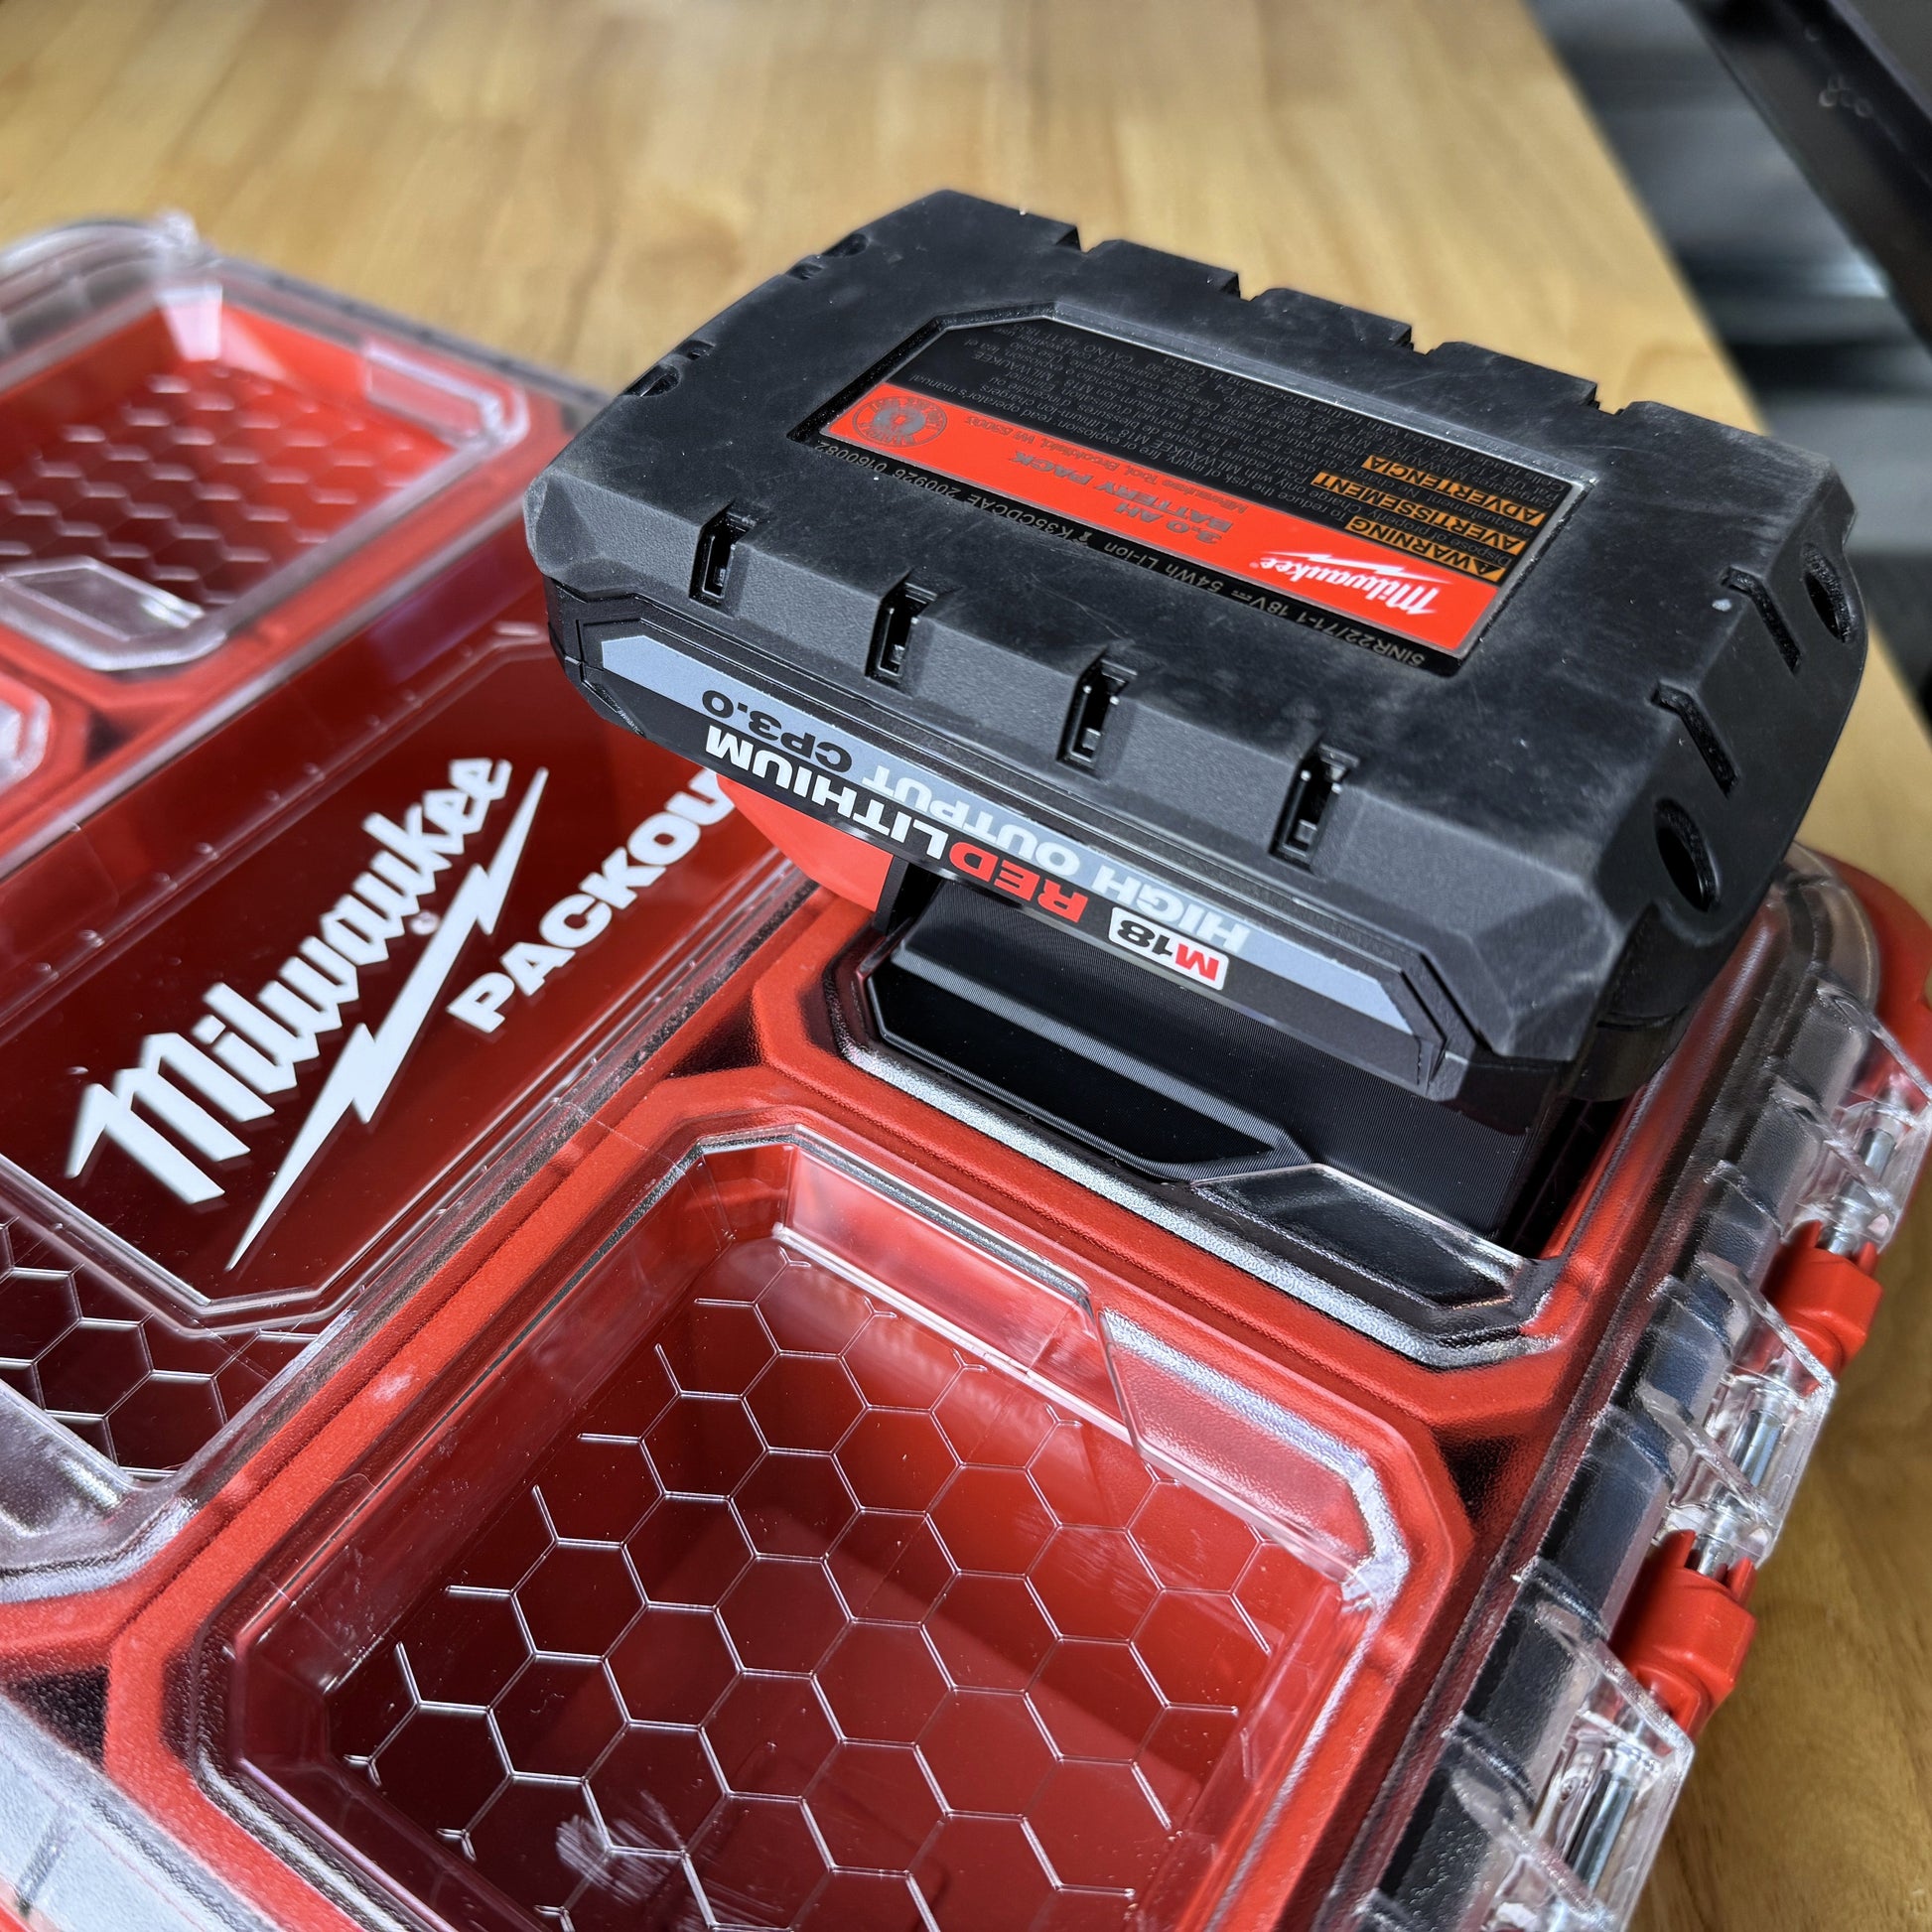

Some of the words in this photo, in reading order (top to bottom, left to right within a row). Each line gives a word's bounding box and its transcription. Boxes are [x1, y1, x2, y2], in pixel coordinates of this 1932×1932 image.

[988, 376, 1008, 386] ou
[958, 388, 1022, 412] operator's
[1007, 382, 1072, 406] d'incendie
[1096, 388, 1169, 416] Lithium-Ion
[1019, 408, 1053, 423] read
[1036, 402, 1109, 431] Lithium-Ion
[1132, 411, 1184, 431] manuel
[1170, 411, 1189, 420] au
[1141, 424, 1162, 435] de
[1162, 431, 1205, 449] risque
[1184, 427, 1200, 437] le
[1190, 417, 1259, 443] chargeurs
[1200, 432, 1229, 446] Lire
[1121, 441, 1139, 450] or
[1138, 446, 1163, 460] fire
[1152, 439, 1242, 474] MILWAUKEE
[1205, 445, 1221, 456] le
[1260, 440, 1282, 453] les
[1015, 452, 1093, 484] PACK
[1166, 454, 1205, 472] injury,
[1238, 444, 1316, 474] d'explosion
[1283, 447, 1338, 469] qu'avec
[891, 469, 960, 498] 200926
[1203, 468, 1222, 478] of
[1225, 474, 1251, 486] risk
[1244, 469, 1274, 483] with
[1273, 467, 1310, 483] Pour
[1340, 466, 1396, 487] charger
[1251, 483, 1276, 496] the
[1275, 478, 1308, 493] only
[1371, 459, 1540, 520] ADVERTENCIA
[1398, 485, 1421, 498] Ne
[1098, 483, 1232, 531] BATTERY
[1277, 491, 1328, 512] reduce
[1309, 489, 1363, 513] Charge
[964, 494, 1073, 538] K35CDCAE
[1115, 502, 1162, 523] AH
[1315, 478, 1519, 548] AVERTISSEMENT
[1329, 508, 1347, 522] To
[1166, 520, 1221, 544] 3.0
[1352, 518, 1471, 568] WARNING
[1428, 531, 1449, 543] of
[1103, 542, 1159, 570] Li-ion
[1448, 538, 1513, 567] Dispose
[1165, 564, 1224, 593] 54Wh
[1260, 557, 1442, 616] Milwaukee
[701, 689, 853, 773] CP3.0
[861, 764, 1081, 878] OUTPUT
[1090, 864, 1252, 955] HIGH
[1117, 918, 1220, 982] M18
[64, 758, 512, 1205] Milwaukee
